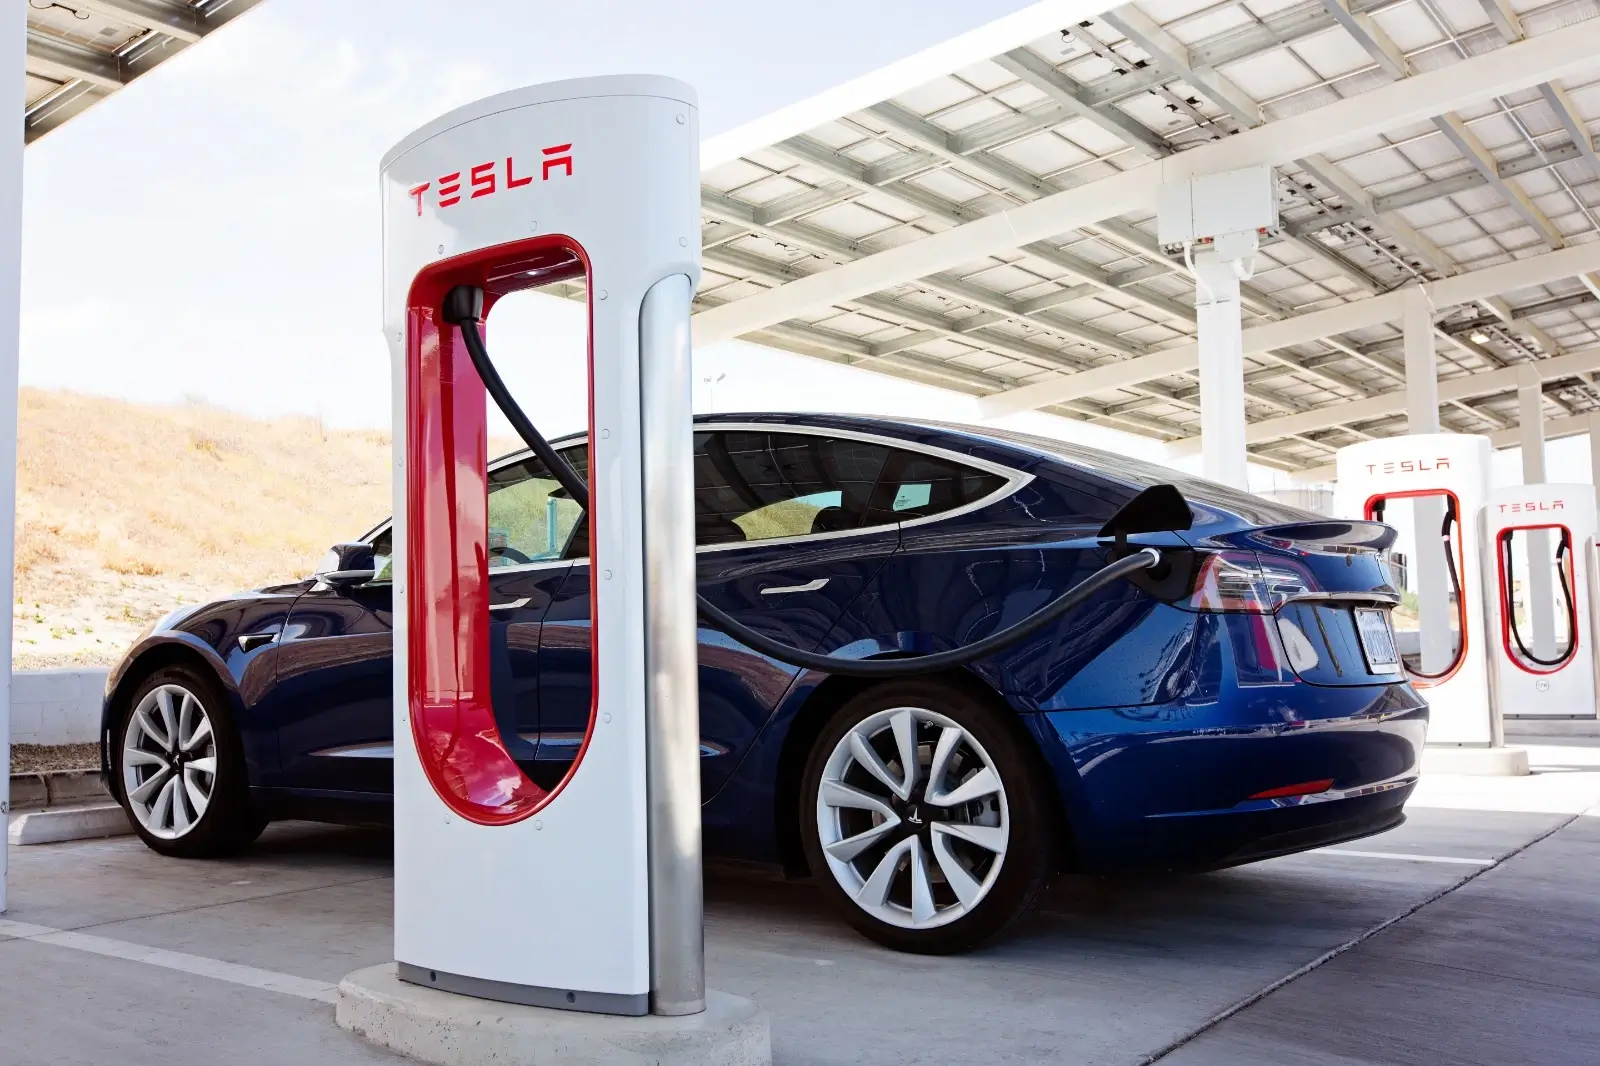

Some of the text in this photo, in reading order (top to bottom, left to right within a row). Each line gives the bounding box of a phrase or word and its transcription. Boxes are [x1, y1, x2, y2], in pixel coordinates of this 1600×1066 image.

[409, 143, 572, 217] TESLA
[1365, 457, 1450, 475] TESLA
[1497, 500, 1564, 513] TESLA
